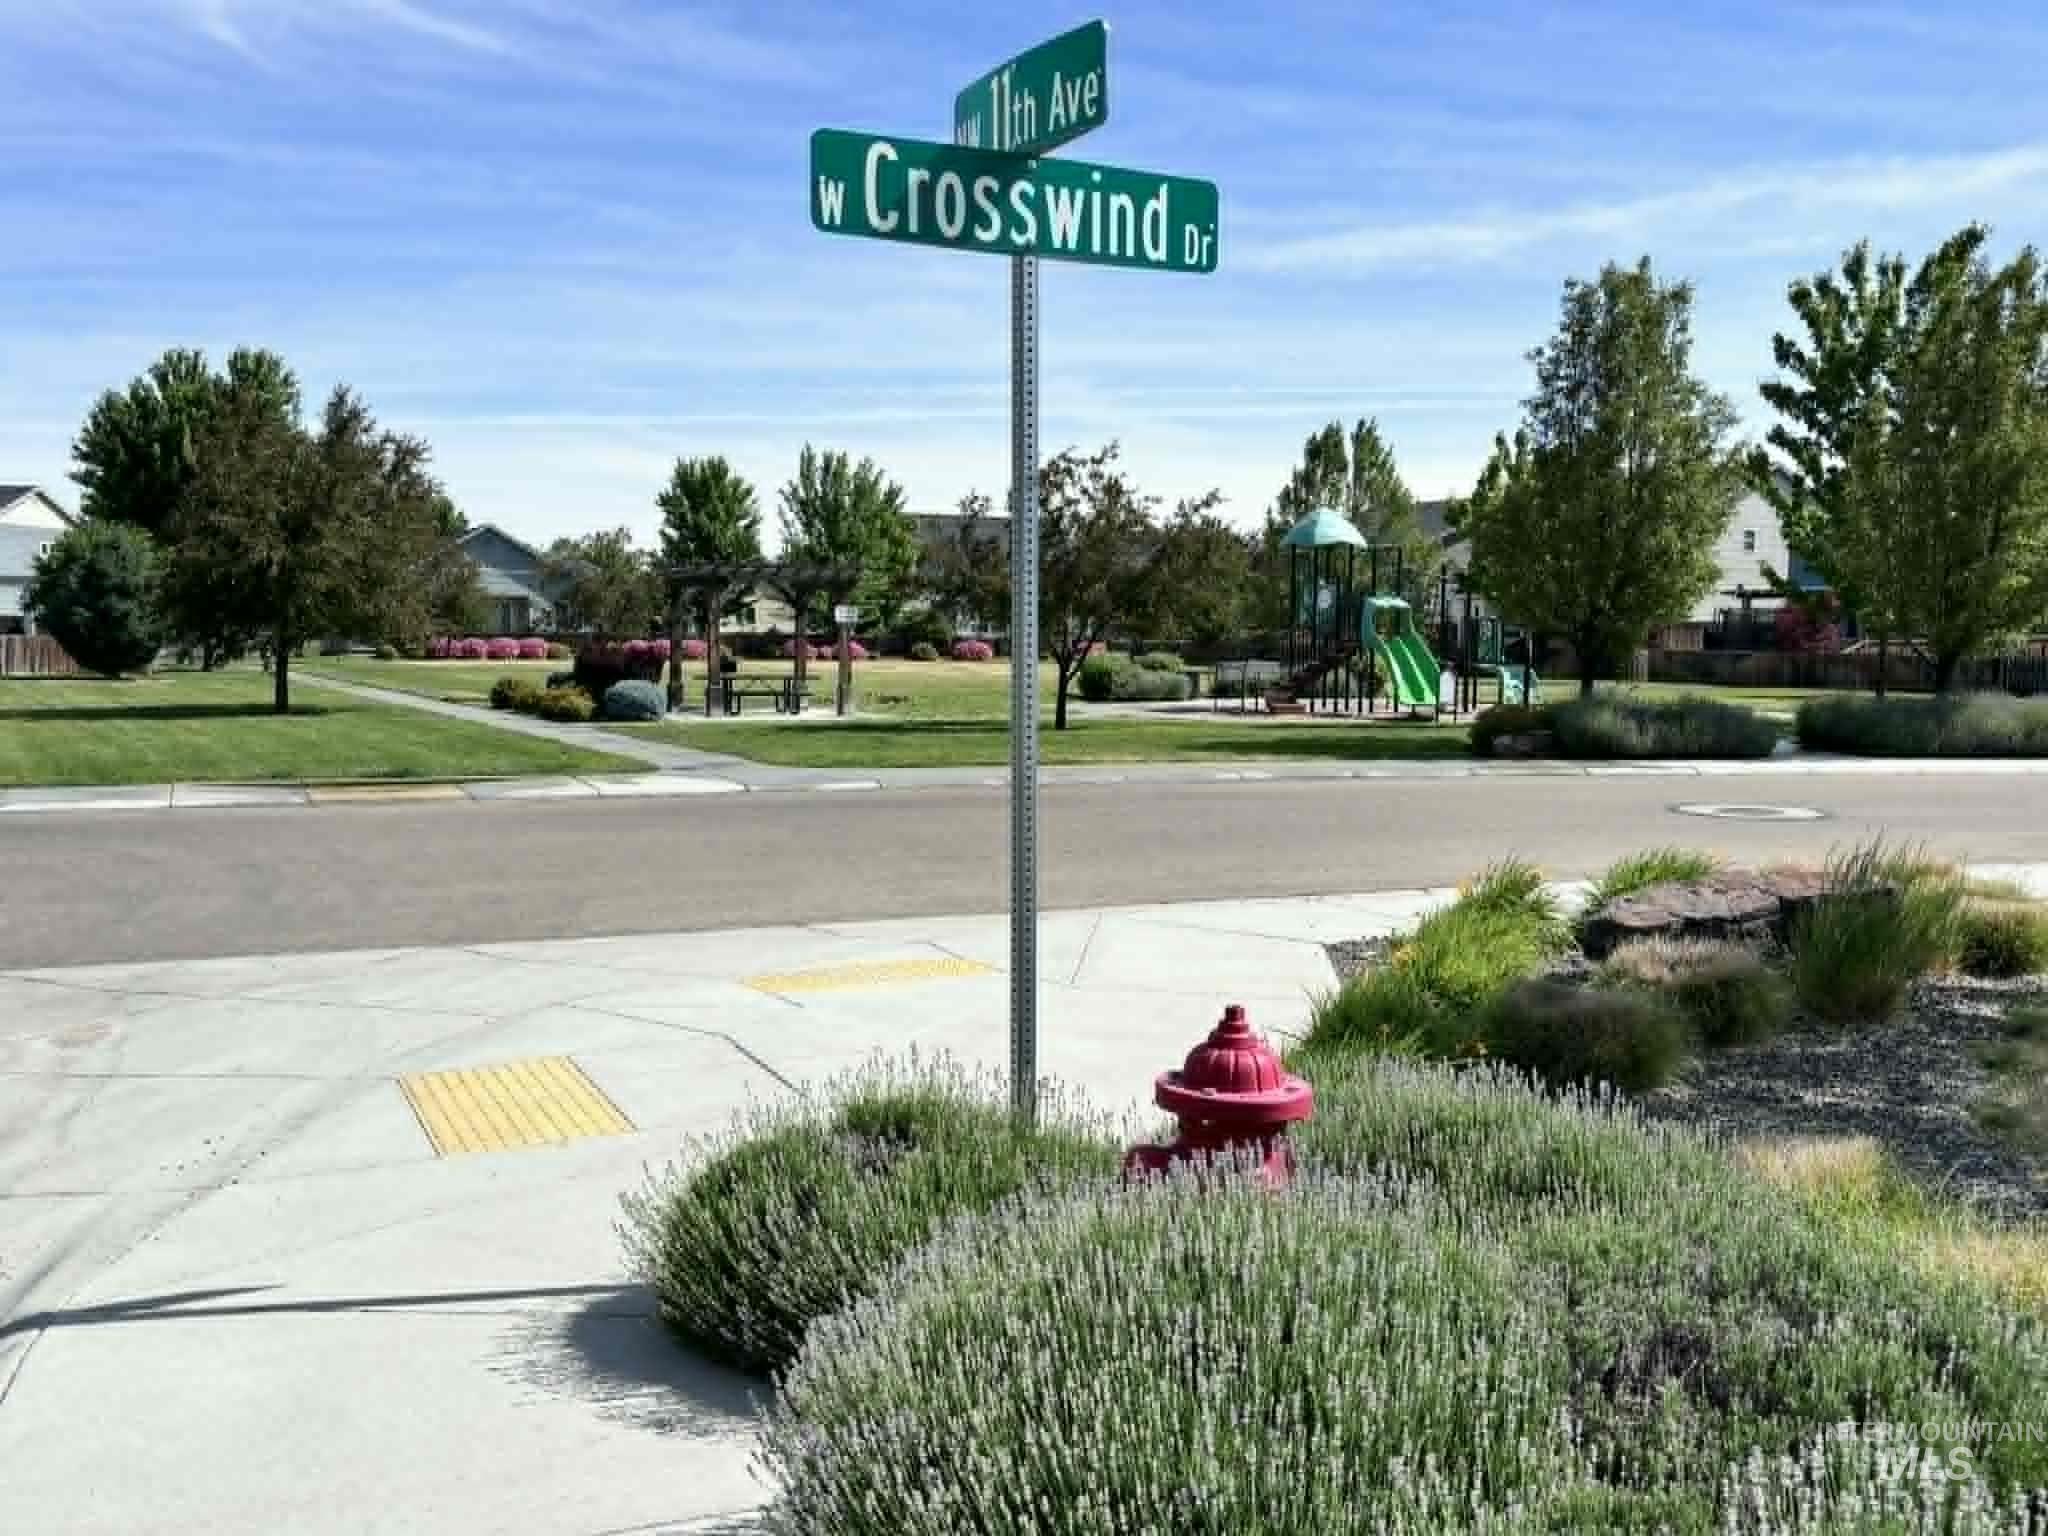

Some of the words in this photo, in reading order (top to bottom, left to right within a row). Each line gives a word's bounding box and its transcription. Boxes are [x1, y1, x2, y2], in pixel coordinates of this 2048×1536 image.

[990, 67, 1036, 152] 11th
[1048, 71, 1098, 132] Ave
[818, 175, 844, 225] W
[864, 141, 1168, 262] Crosswind
[1184, 223, 1211, 266] Dr
